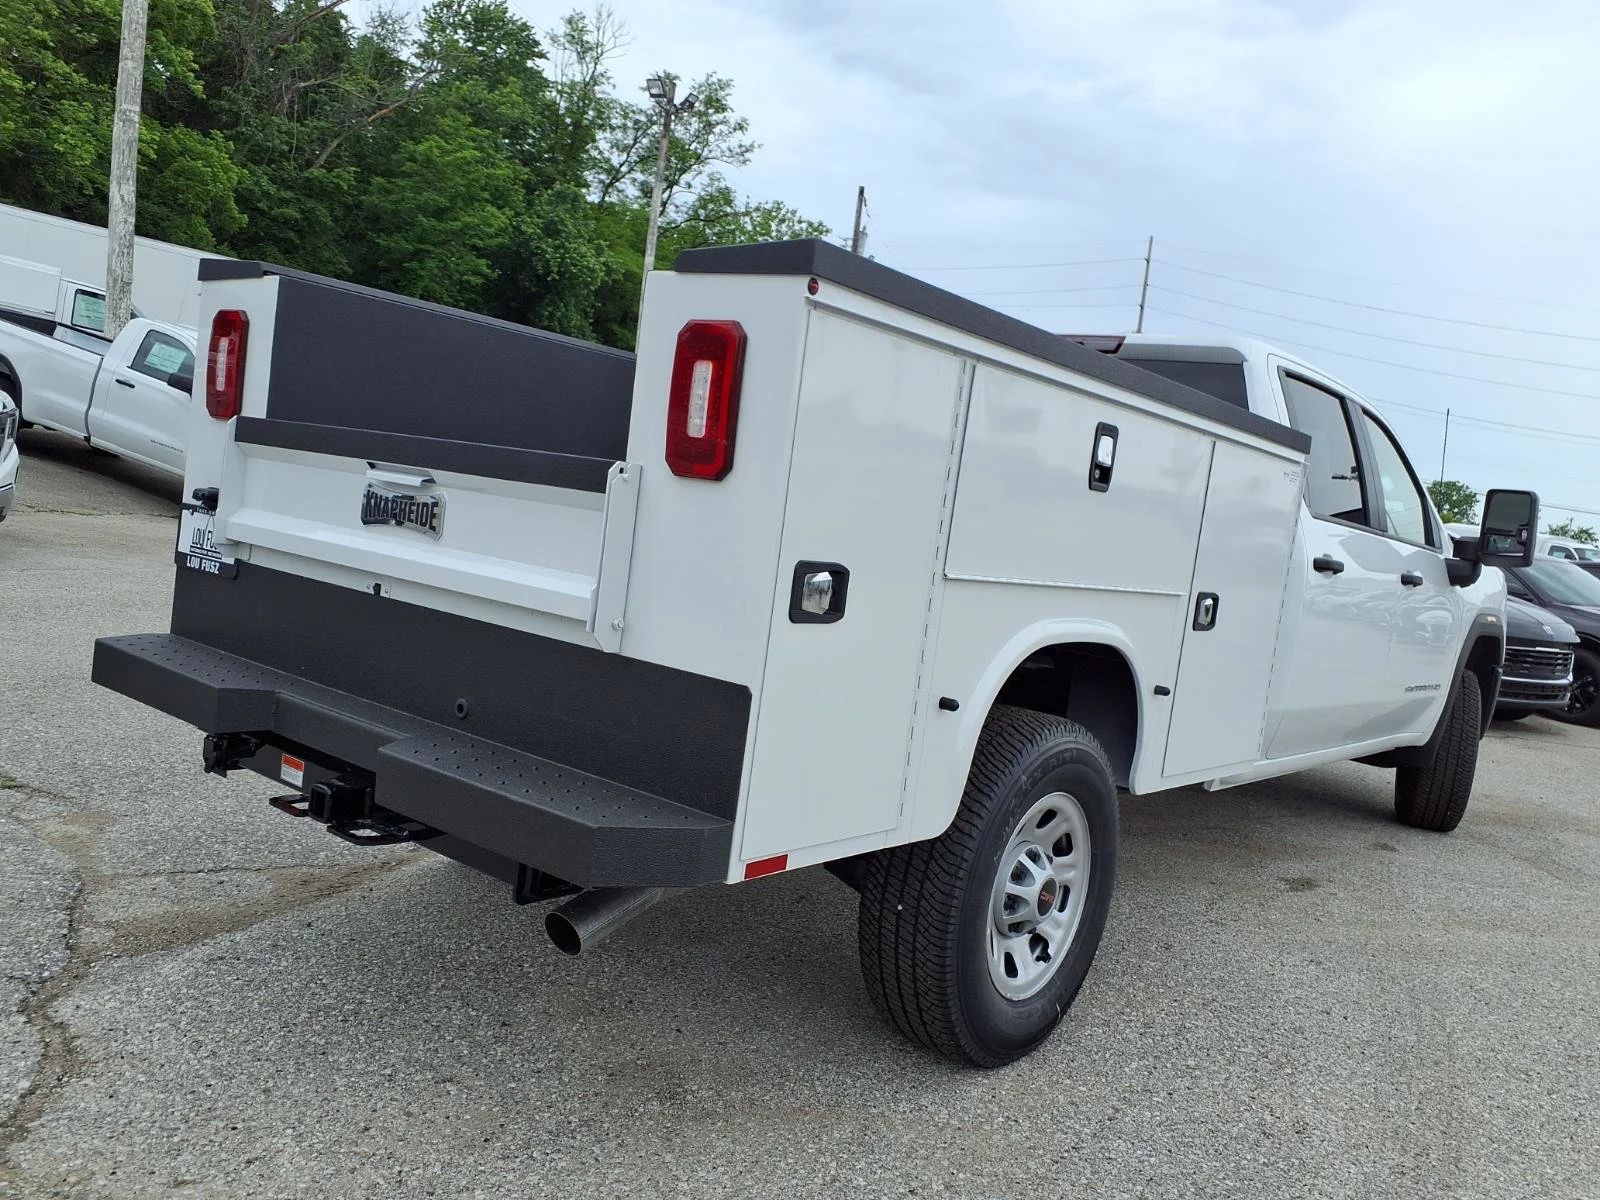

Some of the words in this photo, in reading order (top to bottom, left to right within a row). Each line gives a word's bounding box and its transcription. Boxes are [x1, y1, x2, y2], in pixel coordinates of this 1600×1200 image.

[364, 489, 439, 532] KNAPHEIDE
[187, 555, 200, 569] LOU
[201, 559, 220, 574] FUSZ
